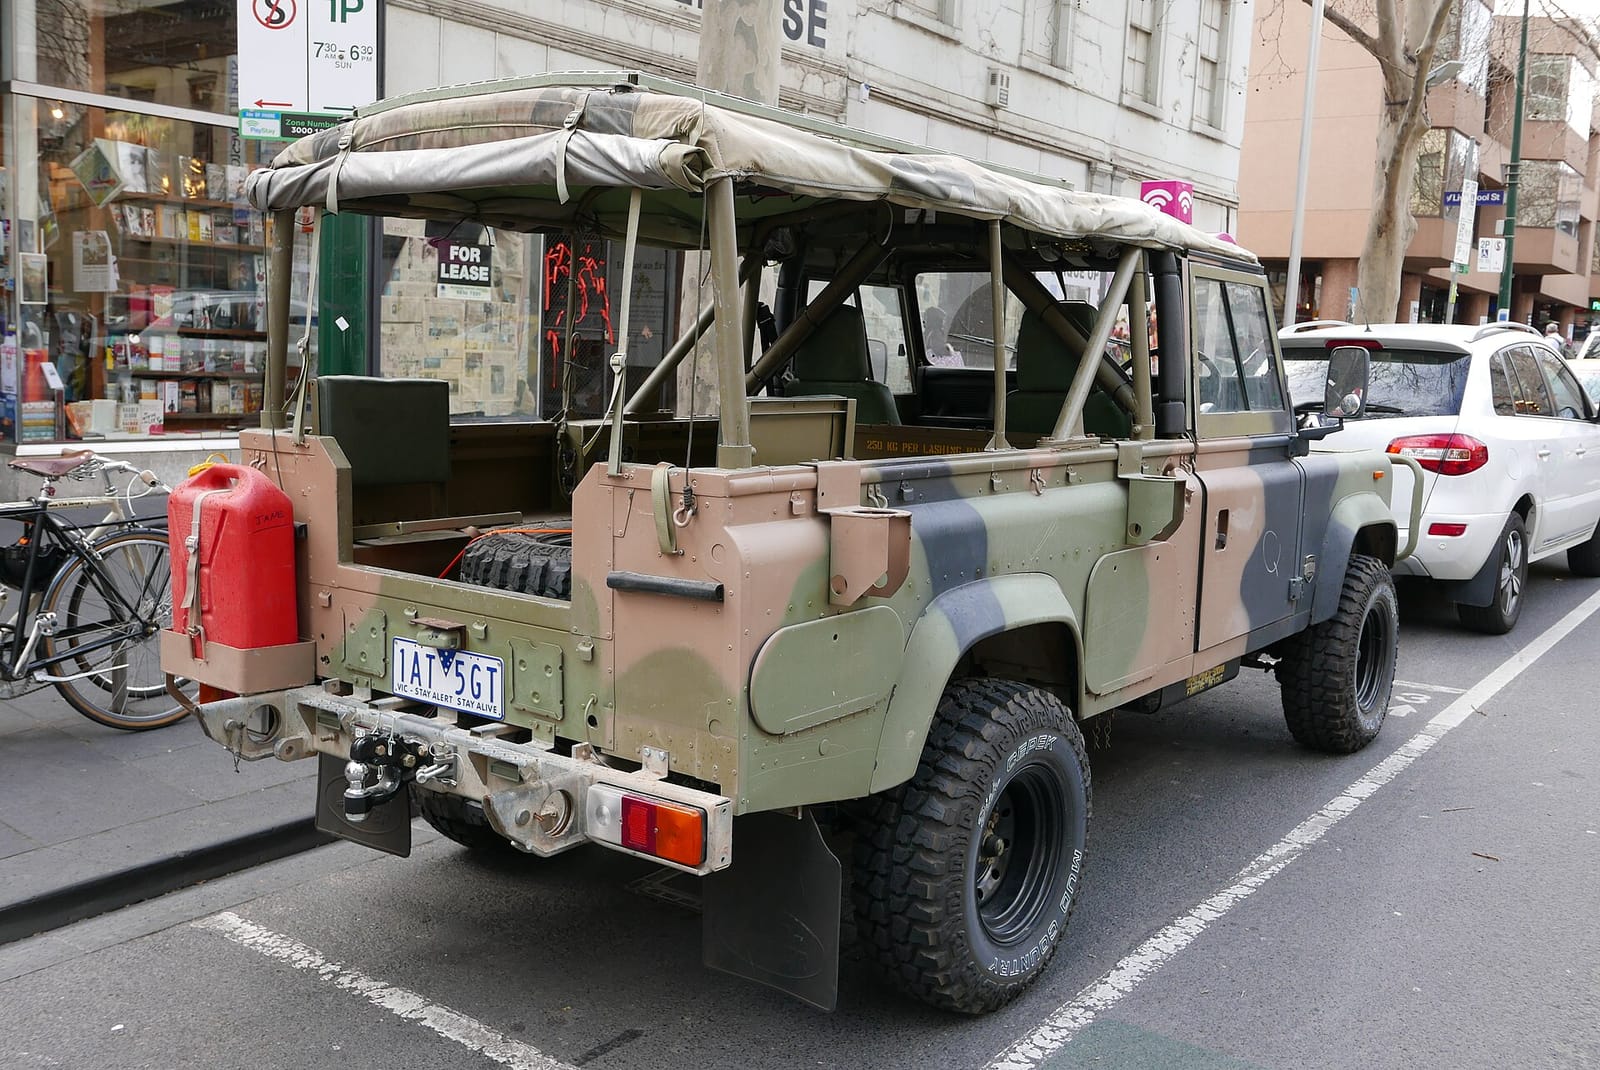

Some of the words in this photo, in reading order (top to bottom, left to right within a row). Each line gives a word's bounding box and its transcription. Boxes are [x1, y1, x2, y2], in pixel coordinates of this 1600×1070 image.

[335, 61, 352, 69] SUN
[285, 118, 306, 127] Zone
[1490, 193, 1501, 201] St
[449, 245, 481, 263] FOR
[440, 262, 489, 282] LEASE
[866, 440, 883, 450] 250
[886, 441, 898, 452] KG
[902, 443, 919, 453] PER
[922, 443, 962, 455] LASHING
[397, 683, 408, 693] VIC
[414, 687, 432, 698] STAY
[432, 691, 453, 704] ALERT
[456, 697, 475, 709] STAY
[476, 702, 498, 714] ALIVE
[1006, 734, 1058, 772] CEPEK
[1059, 848, 1083, 914] MUD
[988, 919, 1059, 977] COUNTRY
